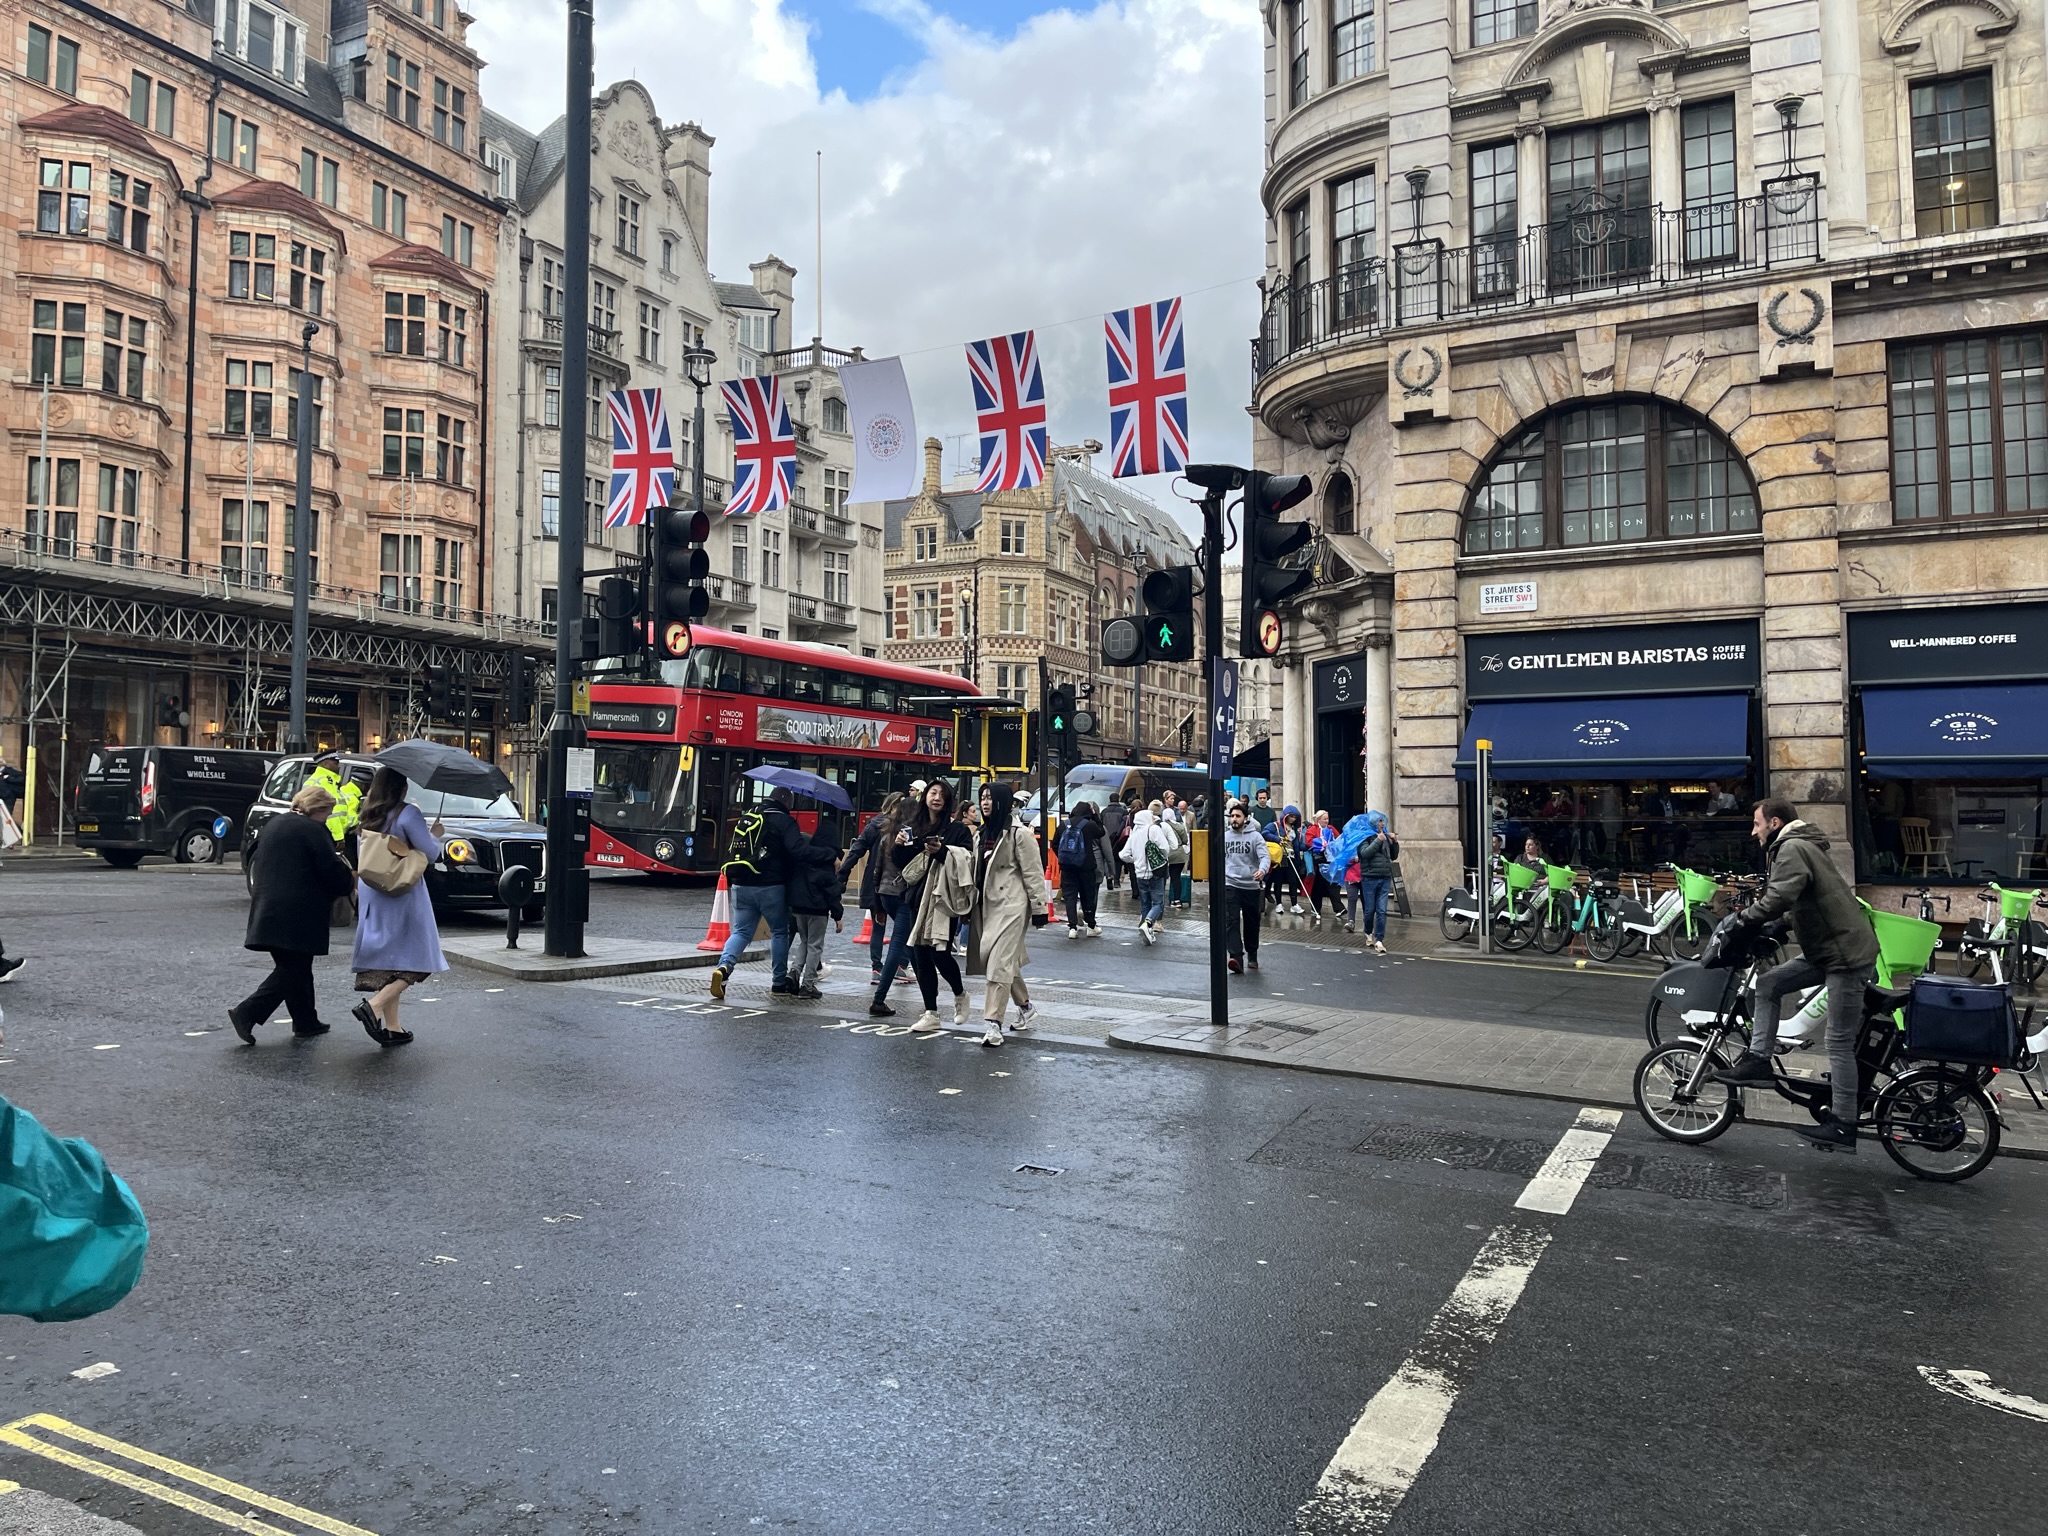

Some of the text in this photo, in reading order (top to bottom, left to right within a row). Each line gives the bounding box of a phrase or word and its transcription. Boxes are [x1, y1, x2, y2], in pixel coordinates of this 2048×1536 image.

[1468, 526, 1540, 540] THOMAS
[1566, 517, 1643, 532] GIBSON
[1670, 512, 1706, 522] FINE
[1485, 584, 1532, 595] ST. JAMES'S
[1485, 594, 1533, 604] STREET SW1
[1889, 634, 2017, 649] WELL-MANNERED COFFEE
[1712, 644, 1746, 653] COFFEE
[1479, 647, 1709, 672] The GENTLEMEN BARISTAS
[1712, 652, 1745, 661] HOUSE
[592, 711, 640, 722] Hammersmith
[719, 709, 743, 718] LONDON
[656, 710, 667, 728] 9
[719, 717, 743, 726] UNITED
[1929, 712, 1999, 727] THE GENTLEMEN
[786, 719, 811, 736] GOOD
[812, 722, 835, 738] TRIPS
[892, 734, 910, 743] Intrepid
[193, 755, 217, 764] RETAIL
[203, 763, 209, 771] &
[186, 770, 226, 780] WHOLESALE
[1661, 907, 1677, 926] Lime
[1664, 985, 1686, 995] Lime
[616, 997, 768, 1019] LEFT
